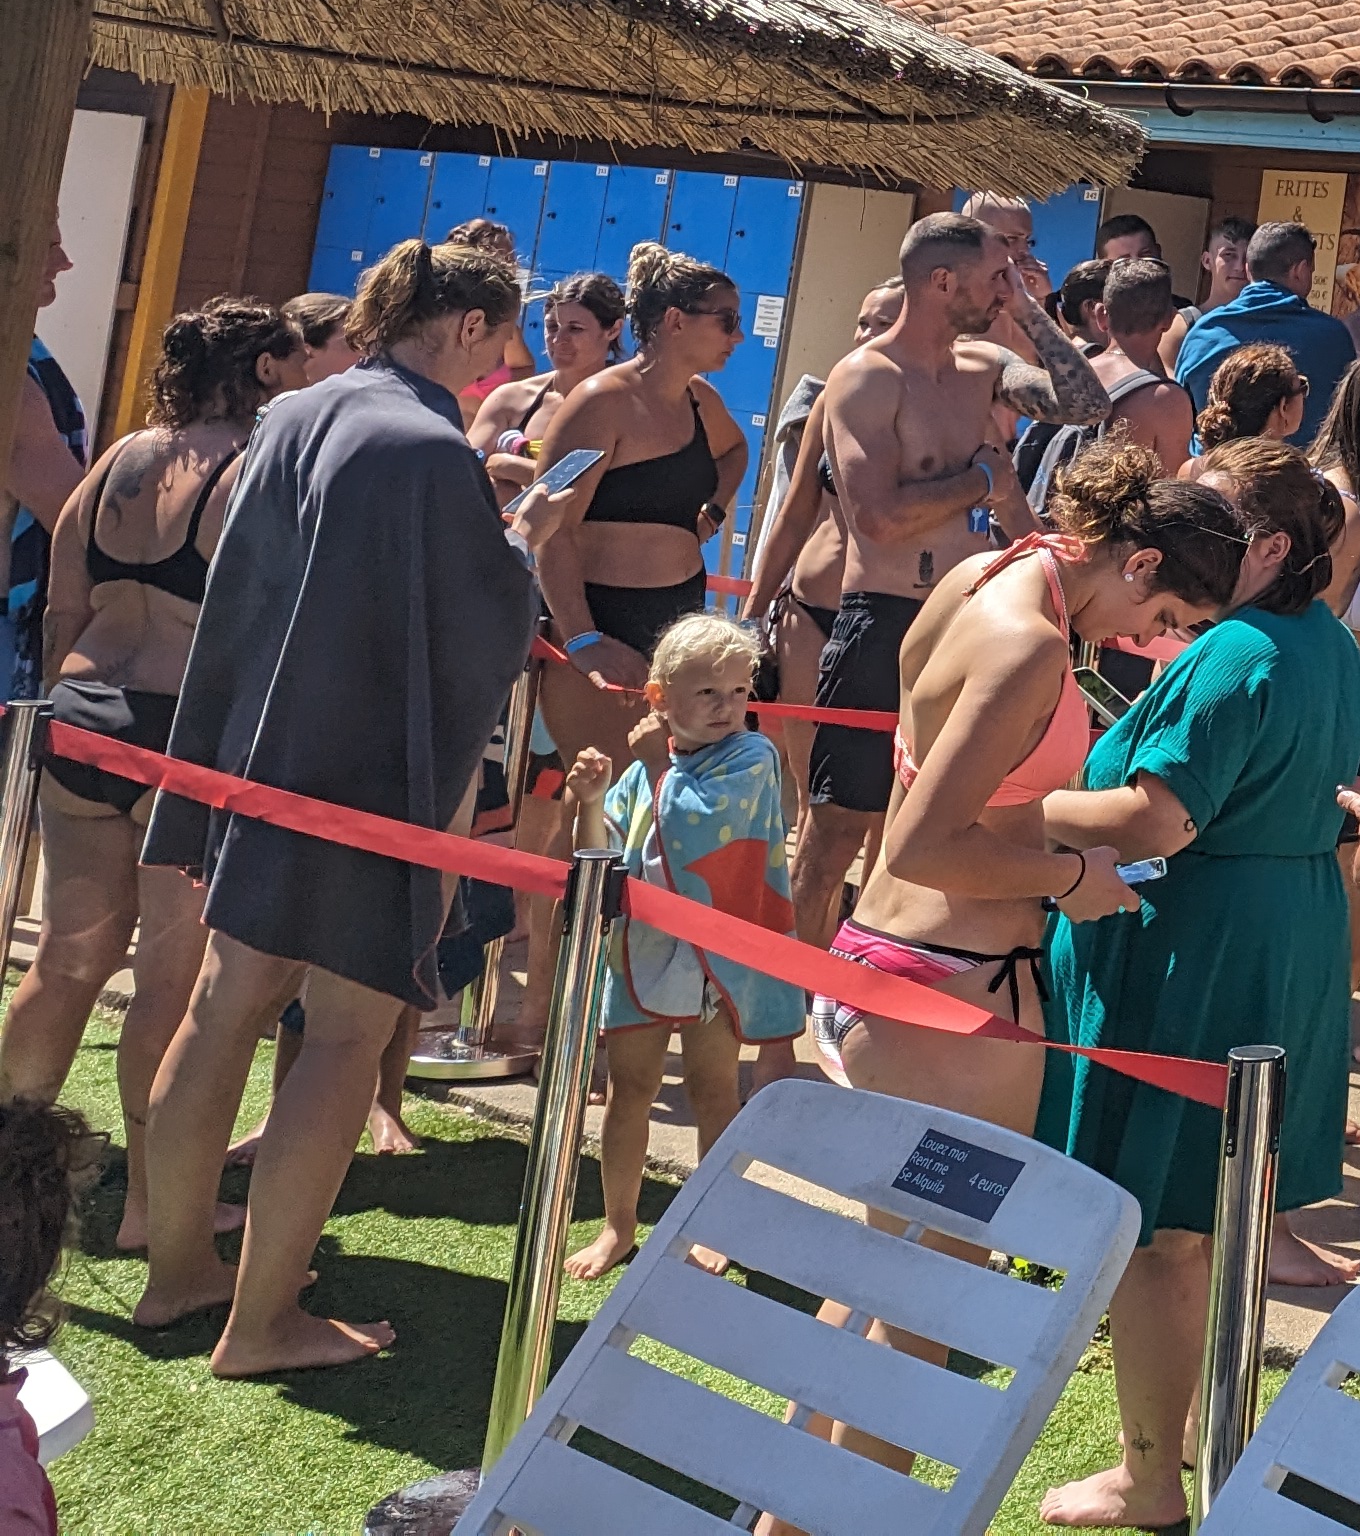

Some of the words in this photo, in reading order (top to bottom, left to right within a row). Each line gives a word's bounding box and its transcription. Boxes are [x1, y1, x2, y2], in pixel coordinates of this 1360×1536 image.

[1275, 179, 1330, 198] FRITES
[1292, 205, 1303, 223] &
[919, 1134, 949, 1156] Louez
[948, 1148, 971, 1162] moi
[909, 1151, 932, 1170] Rent
[932, 1162, 950, 1176] me
[898, 1167, 912, 1182] Se
[911, 1172, 945, 1194] Alquila
[968, 1172, 978, 1186] 4
[977, 1177, 1009, 1197] euros
